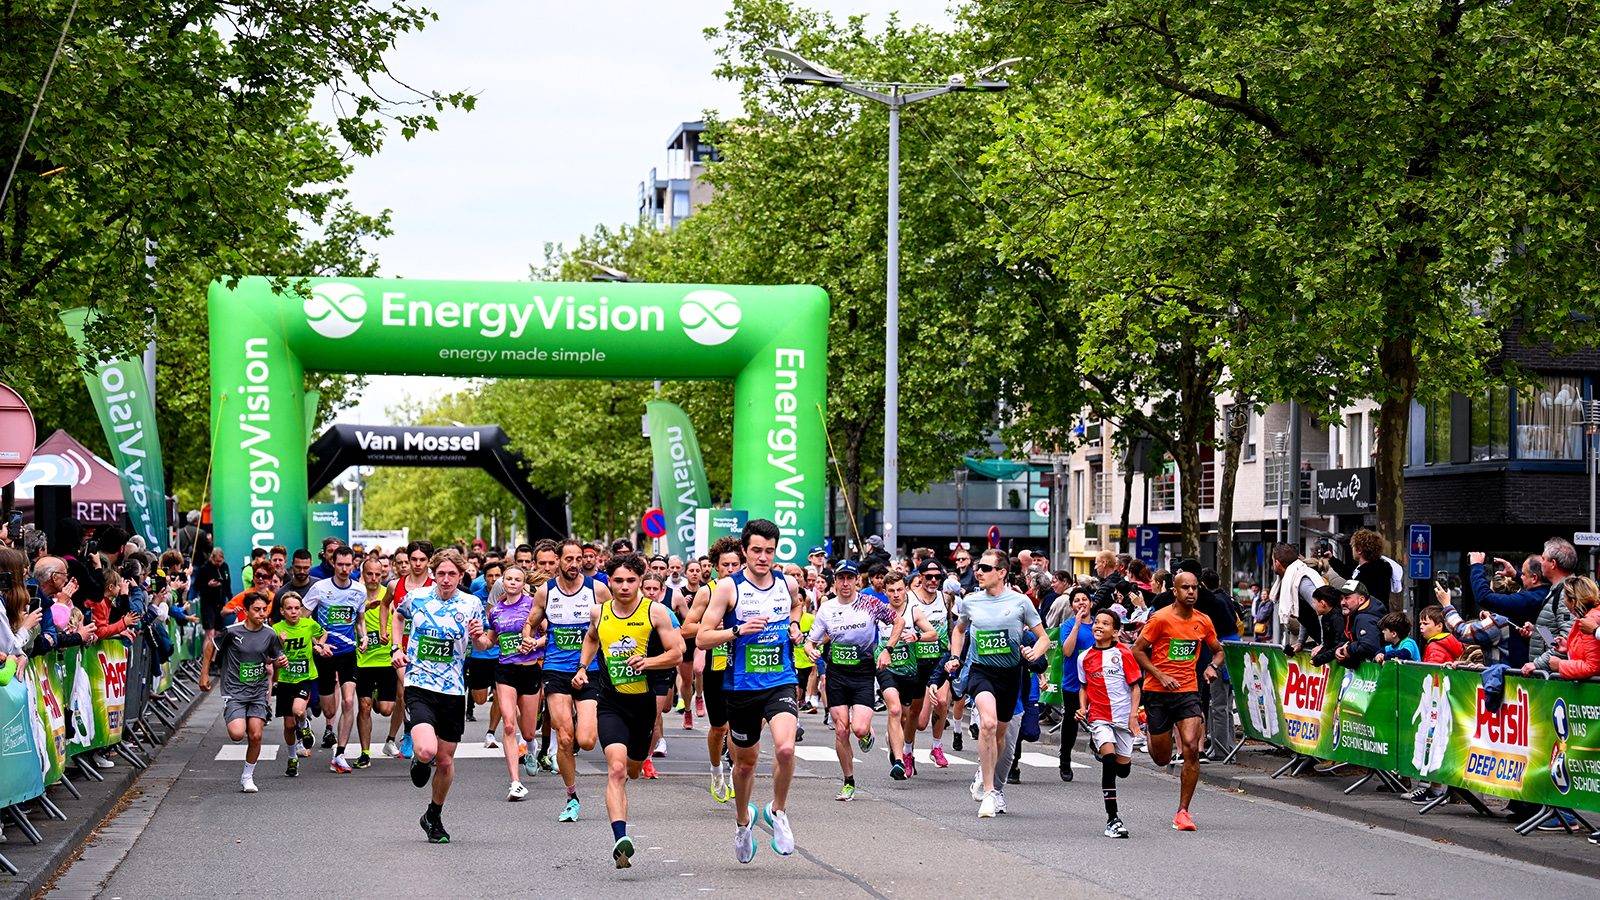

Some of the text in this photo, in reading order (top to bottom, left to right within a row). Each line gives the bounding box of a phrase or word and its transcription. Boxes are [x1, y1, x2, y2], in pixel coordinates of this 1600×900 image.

[382, 292, 665, 338] EnergyVision
[439, 347, 606, 364] energy made simple
[355, 431, 480, 451] Van Mossel
[238, 337, 280, 567] nergyVision
[767, 349, 805, 566] EnergyVisio
[1141, 529, 1153, 546] P
[330, 611, 351, 620] 3563
[502, 637, 523, 650] 335
[557, 635, 582, 645] 3774
[979, 638, 1007, 649] 3428
[420, 644, 450, 657] 3742
[834, 651, 858, 660] 3523
[917, 645, 940, 654] 3503
[1171, 646, 1196, 655] 3387
[750, 654, 779, 666] 3813
[1283, 663, 1330, 712] Persil
[1473, 687, 1528, 747] Persil
[1568, 704, 1582, 719] EEN
[1570, 723, 1587, 737] WAS
[1467, 753, 1526, 783] DEEP CLEAN
[1568, 758, 1584, 773] EEN
